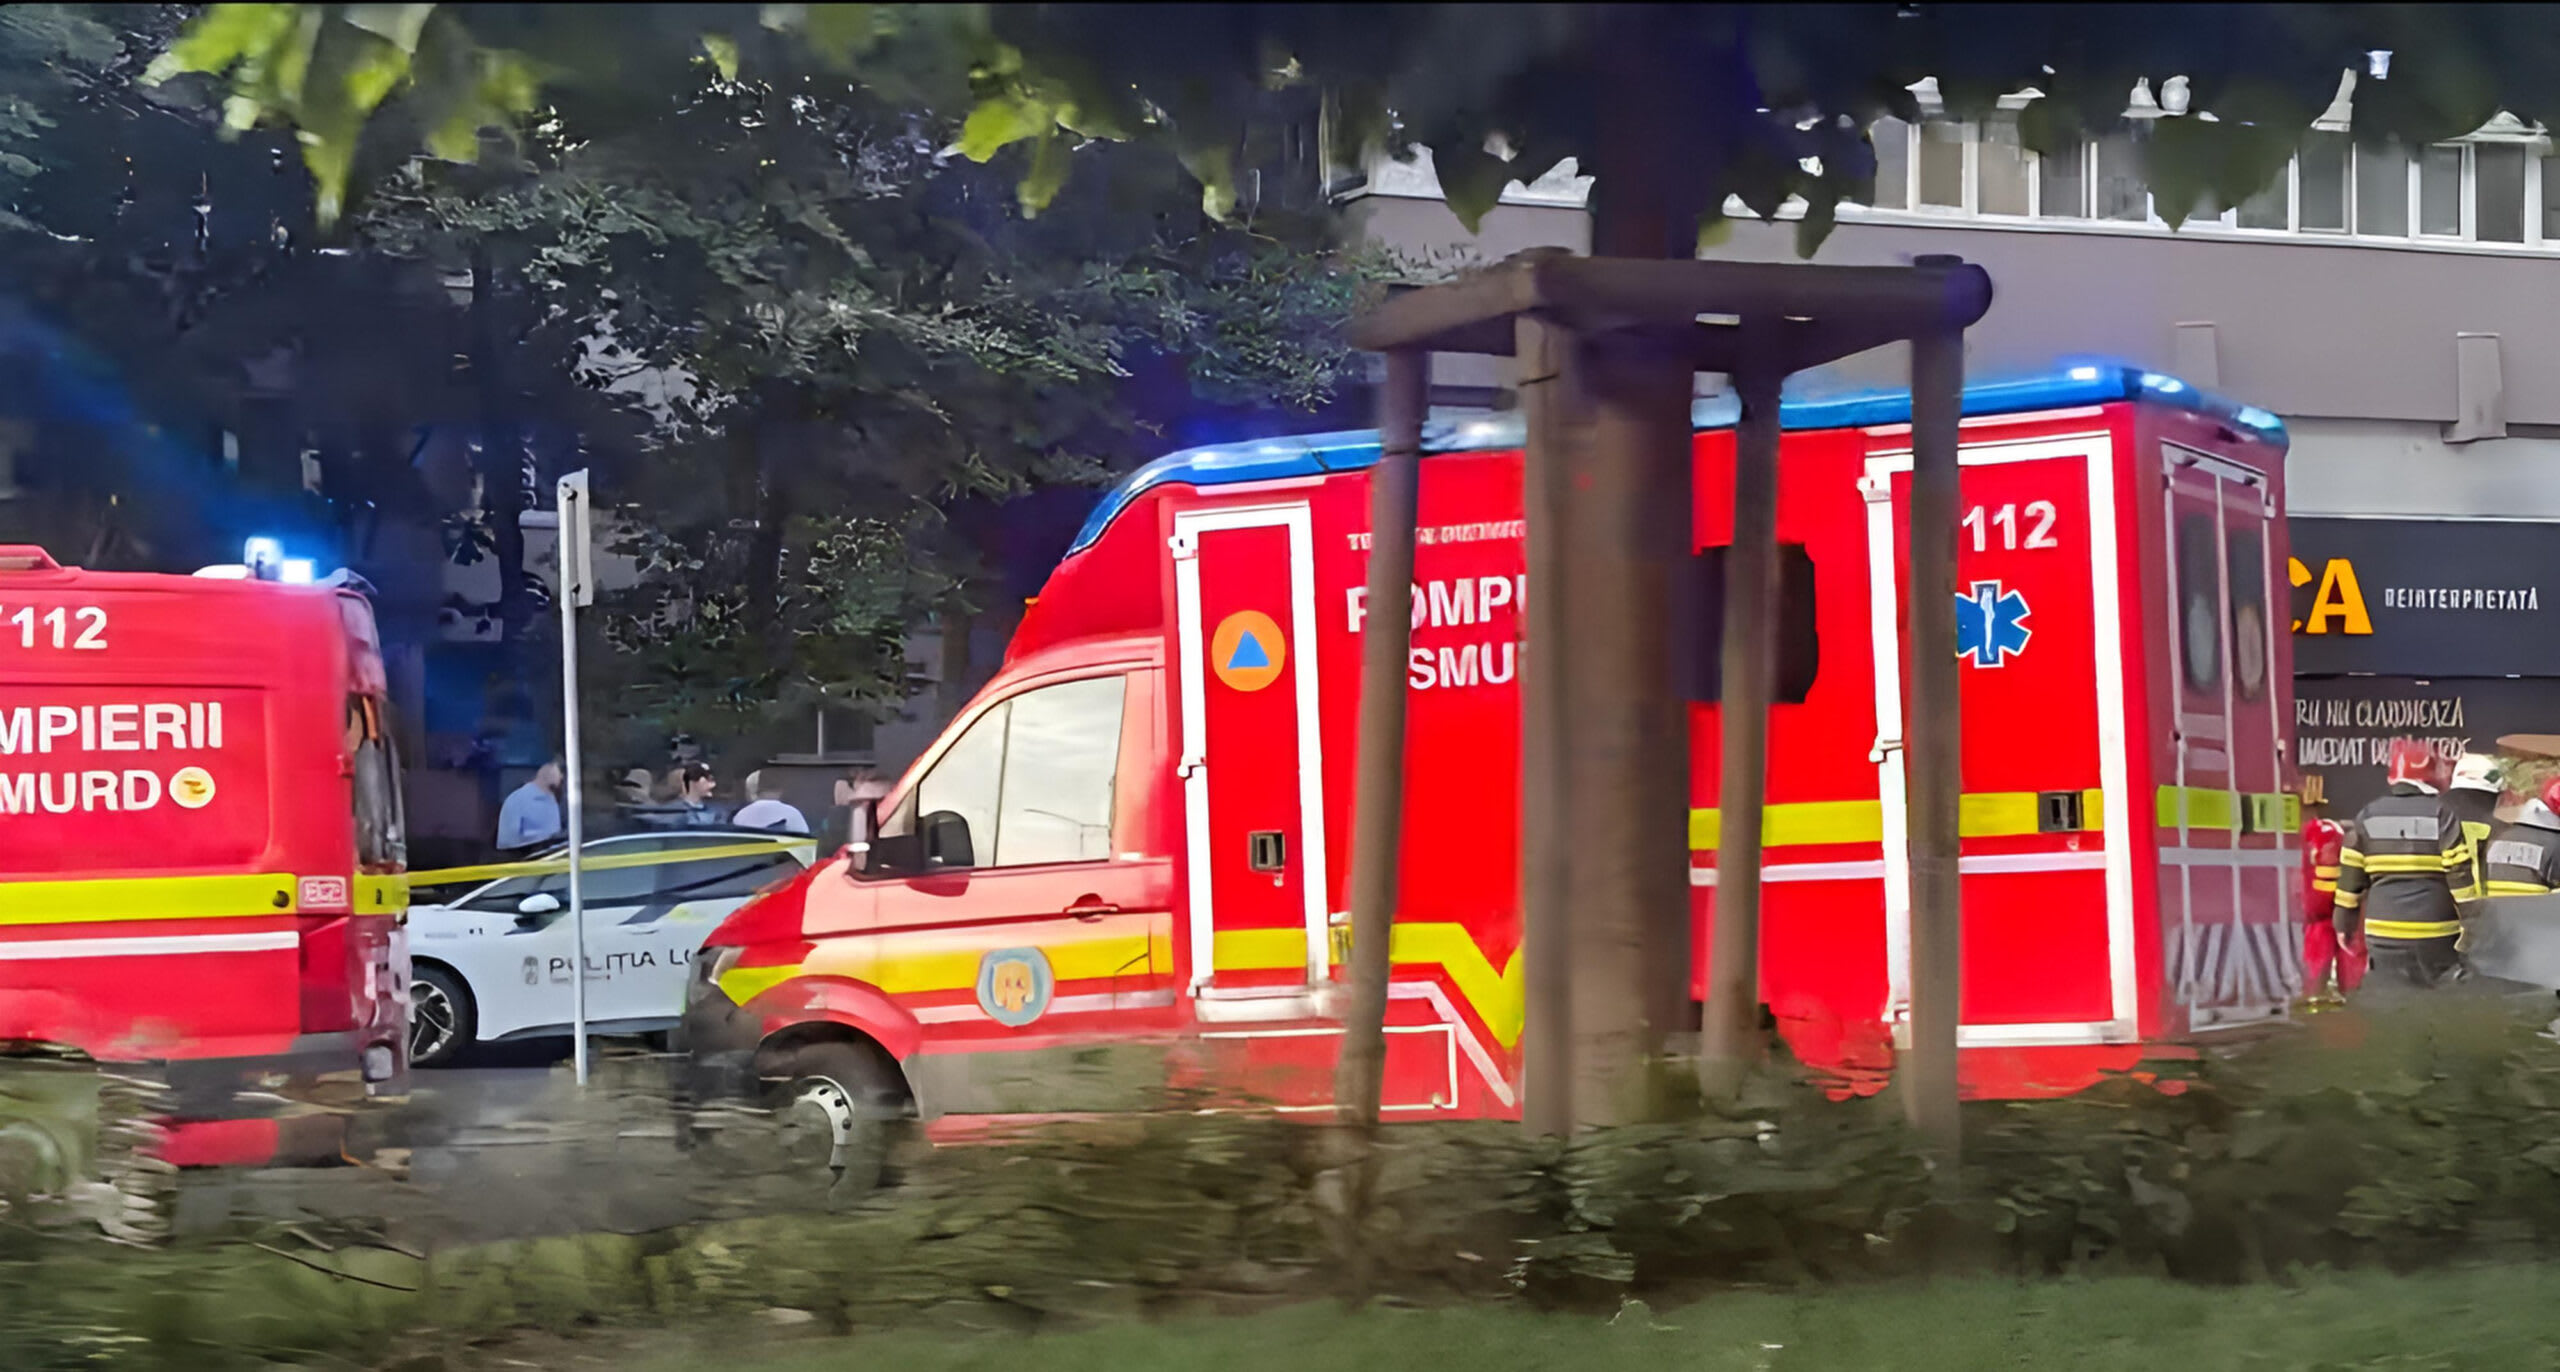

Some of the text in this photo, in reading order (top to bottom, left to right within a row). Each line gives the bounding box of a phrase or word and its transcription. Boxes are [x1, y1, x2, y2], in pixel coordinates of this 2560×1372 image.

[1962, 500, 2058, 552] 112
[2288, 557, 2373, 634] A
[11, 606, 108, 650] 112
[1409, 641, 1527, 690] SMU
[0, 770, 162, 814] MURD
